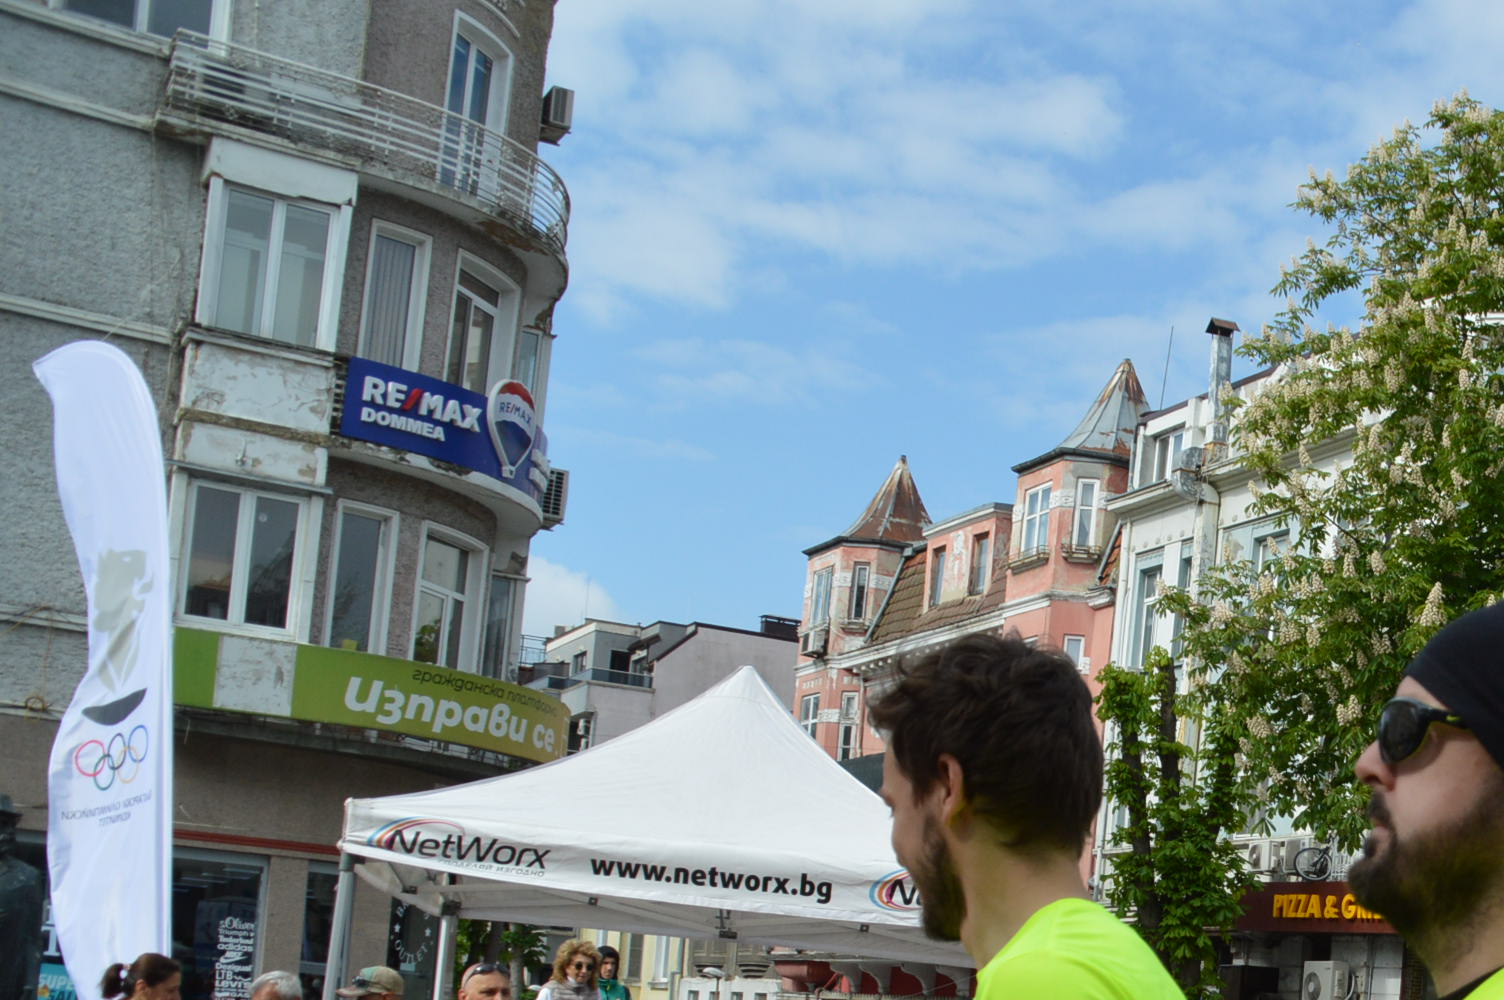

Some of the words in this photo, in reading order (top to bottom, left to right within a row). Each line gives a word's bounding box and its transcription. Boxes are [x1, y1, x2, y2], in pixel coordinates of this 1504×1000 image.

[362, 375, 482, 433] RE/MAX
[499, 401, 532, 424] RE/MAX
[360, 406, 446, 442] DOMMEA
[411, 668, 505, 700] гражданска
[388, 829, 552, 869] NetWorx
[590, 857, 833, 904] www.networx.bg
[1272, 893, 1322, 919] PIZZA
[1323, 894, 1340, 919] &
[217, 943, 254, 952] adidas
[216, 970, 233, 980] LTB
